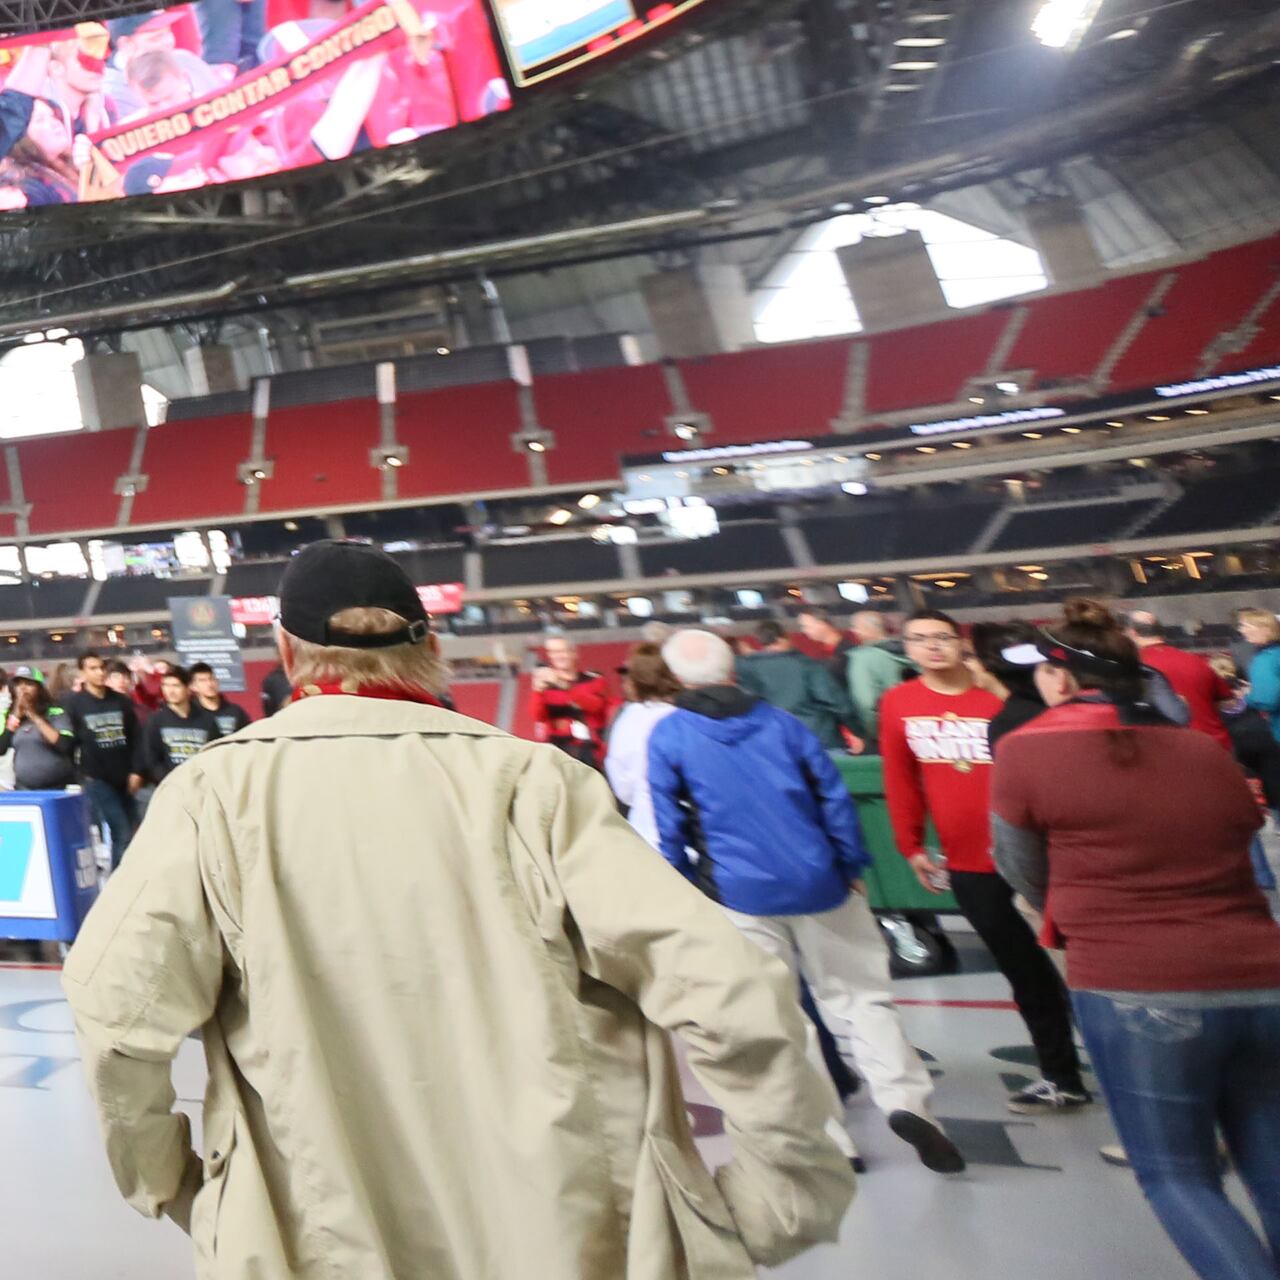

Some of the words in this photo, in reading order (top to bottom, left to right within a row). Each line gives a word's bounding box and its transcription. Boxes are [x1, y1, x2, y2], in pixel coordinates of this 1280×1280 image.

[101, 111, 192, 162] QUIERO
[192, 66, 291, 128] CONTAR
[288, 4, 398, 80] CONTIGO
[905, 719, 988, 739] ATLANT
[906, 737, 993, 761] UNITE
